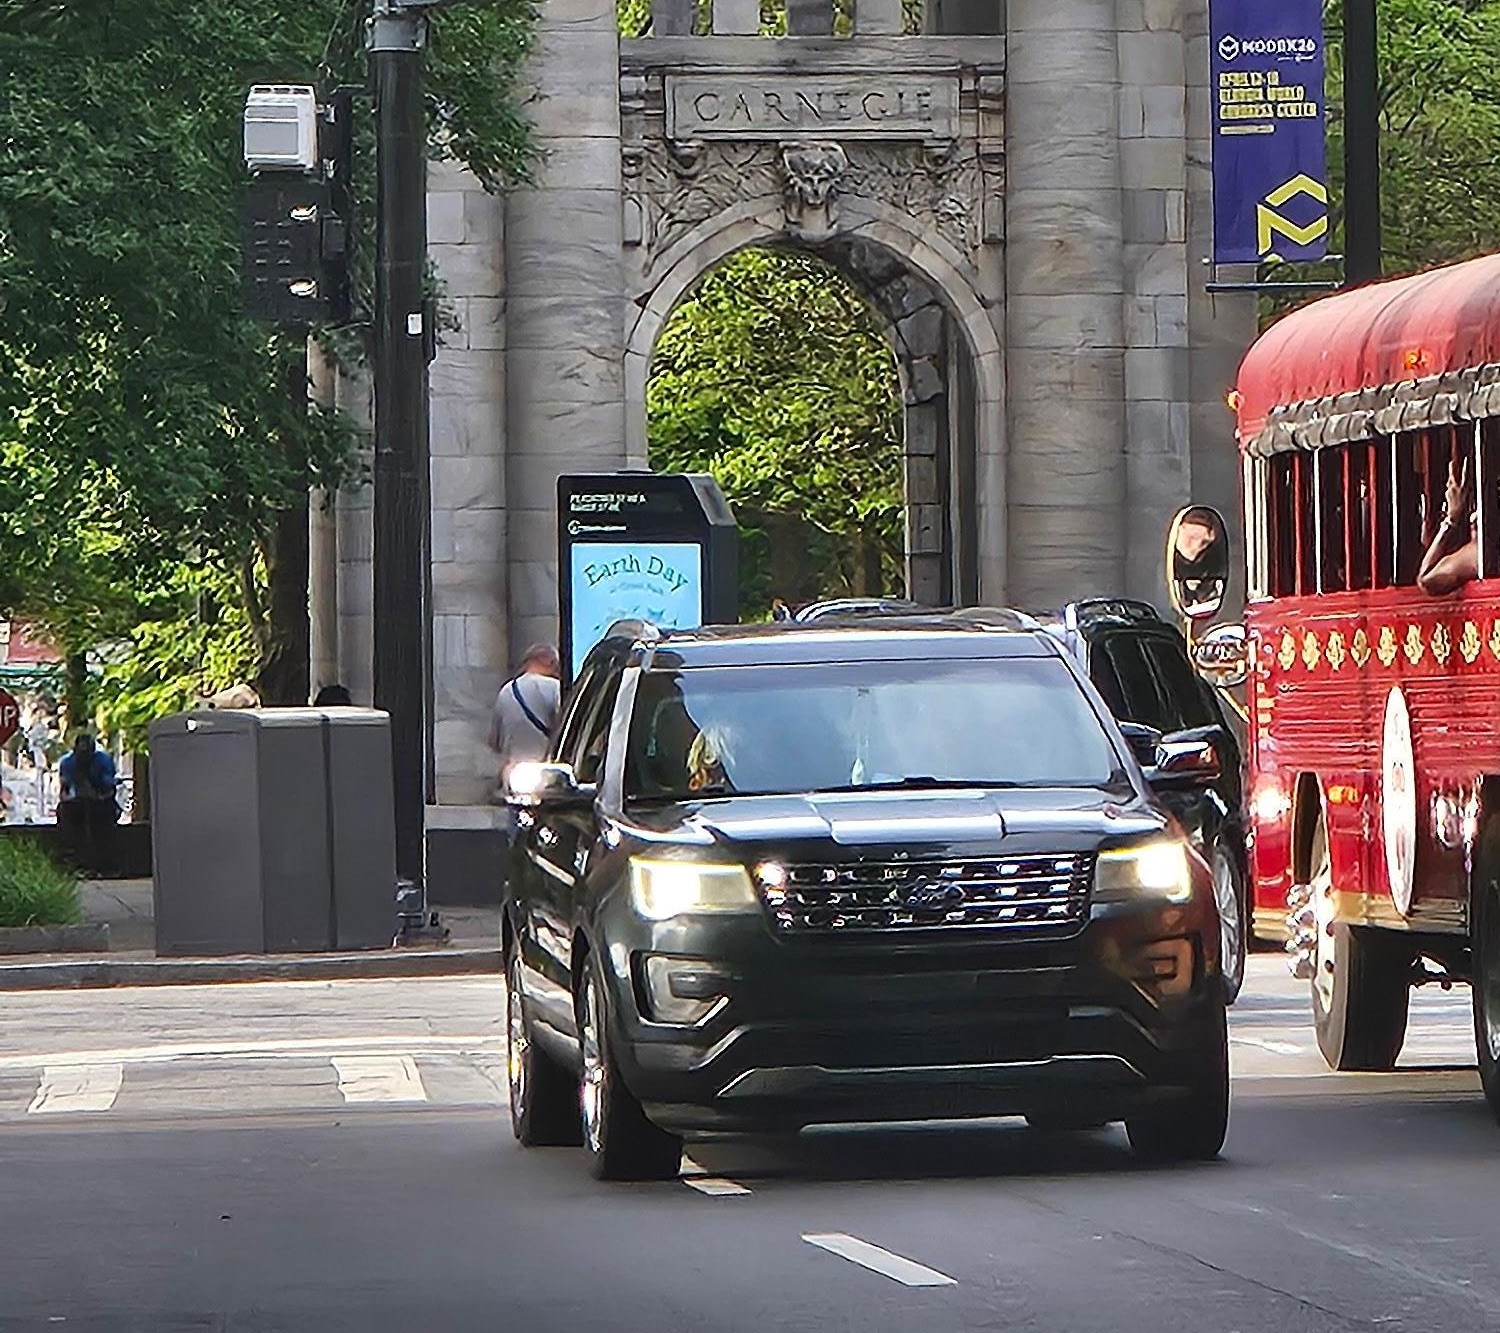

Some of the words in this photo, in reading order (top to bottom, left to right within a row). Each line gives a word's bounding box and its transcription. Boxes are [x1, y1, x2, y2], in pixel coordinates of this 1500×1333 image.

[692, 91, 932, 122] CARNEGIE
[583, 553, 641, 587] Earth
[646, 555, 689, 593] Day
